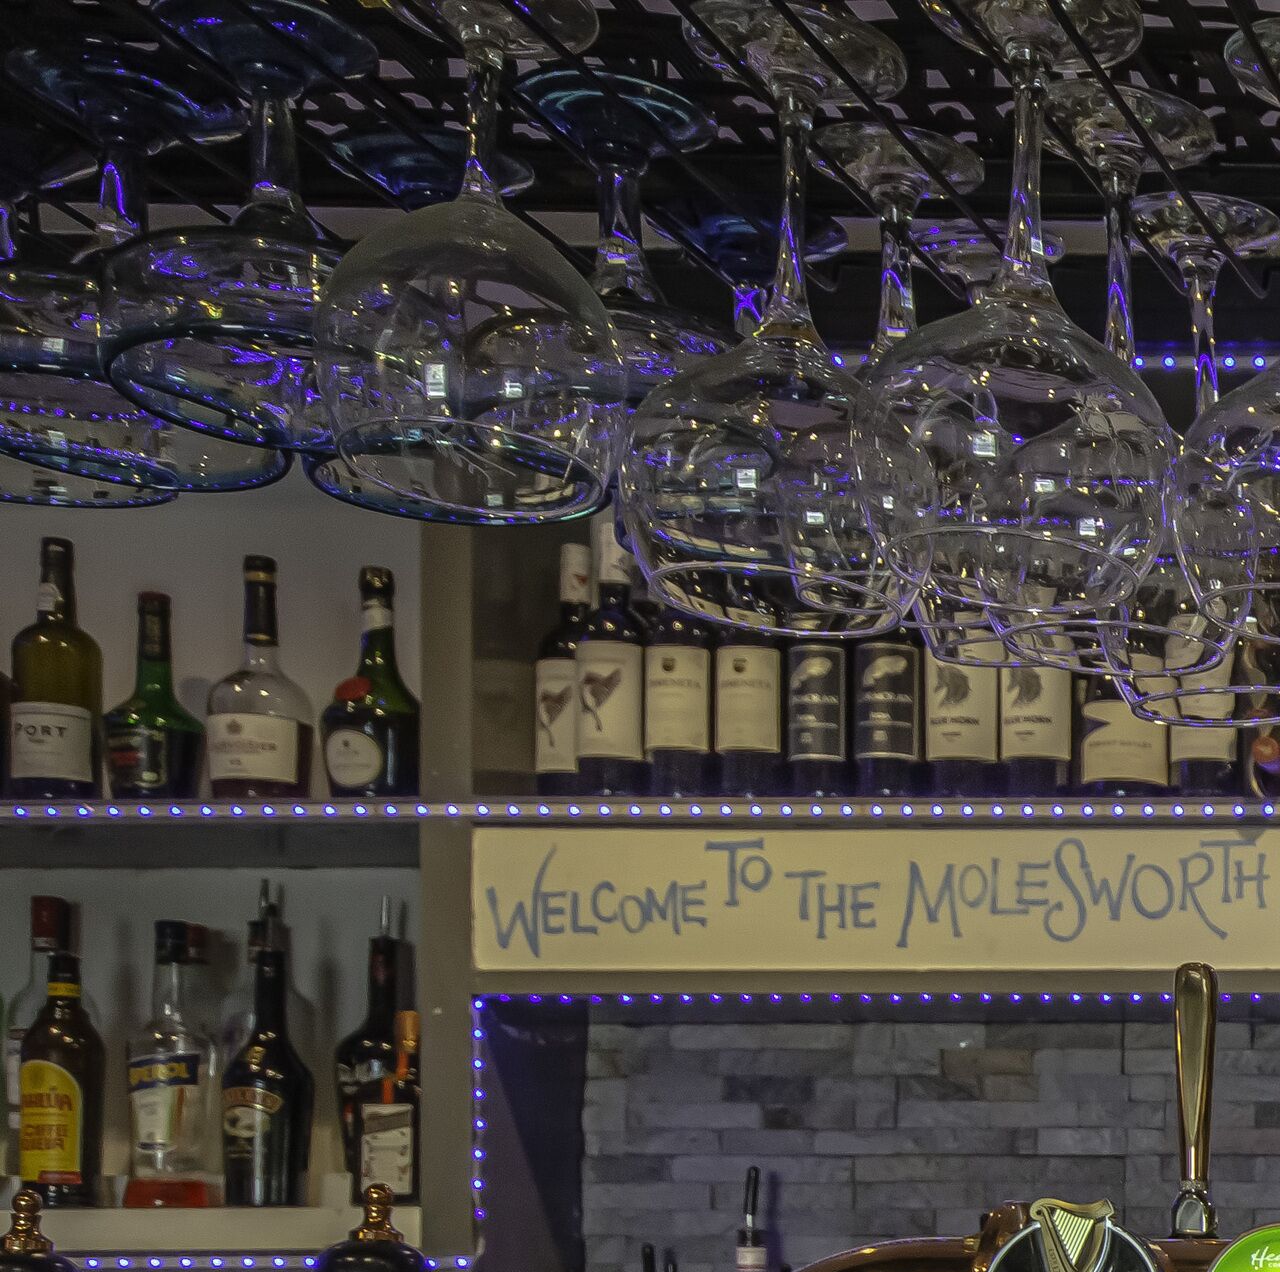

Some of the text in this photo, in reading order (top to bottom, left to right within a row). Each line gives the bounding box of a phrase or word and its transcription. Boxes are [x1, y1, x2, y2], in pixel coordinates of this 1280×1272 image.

[14, 722, 68, 740] PORT
[486, 843, 708, 959] WELCOME
[705, 837, 773, 907] TO
[783, 869, 882, 940] THE
[896, 837, 1270, 949] MOLESWORTH
